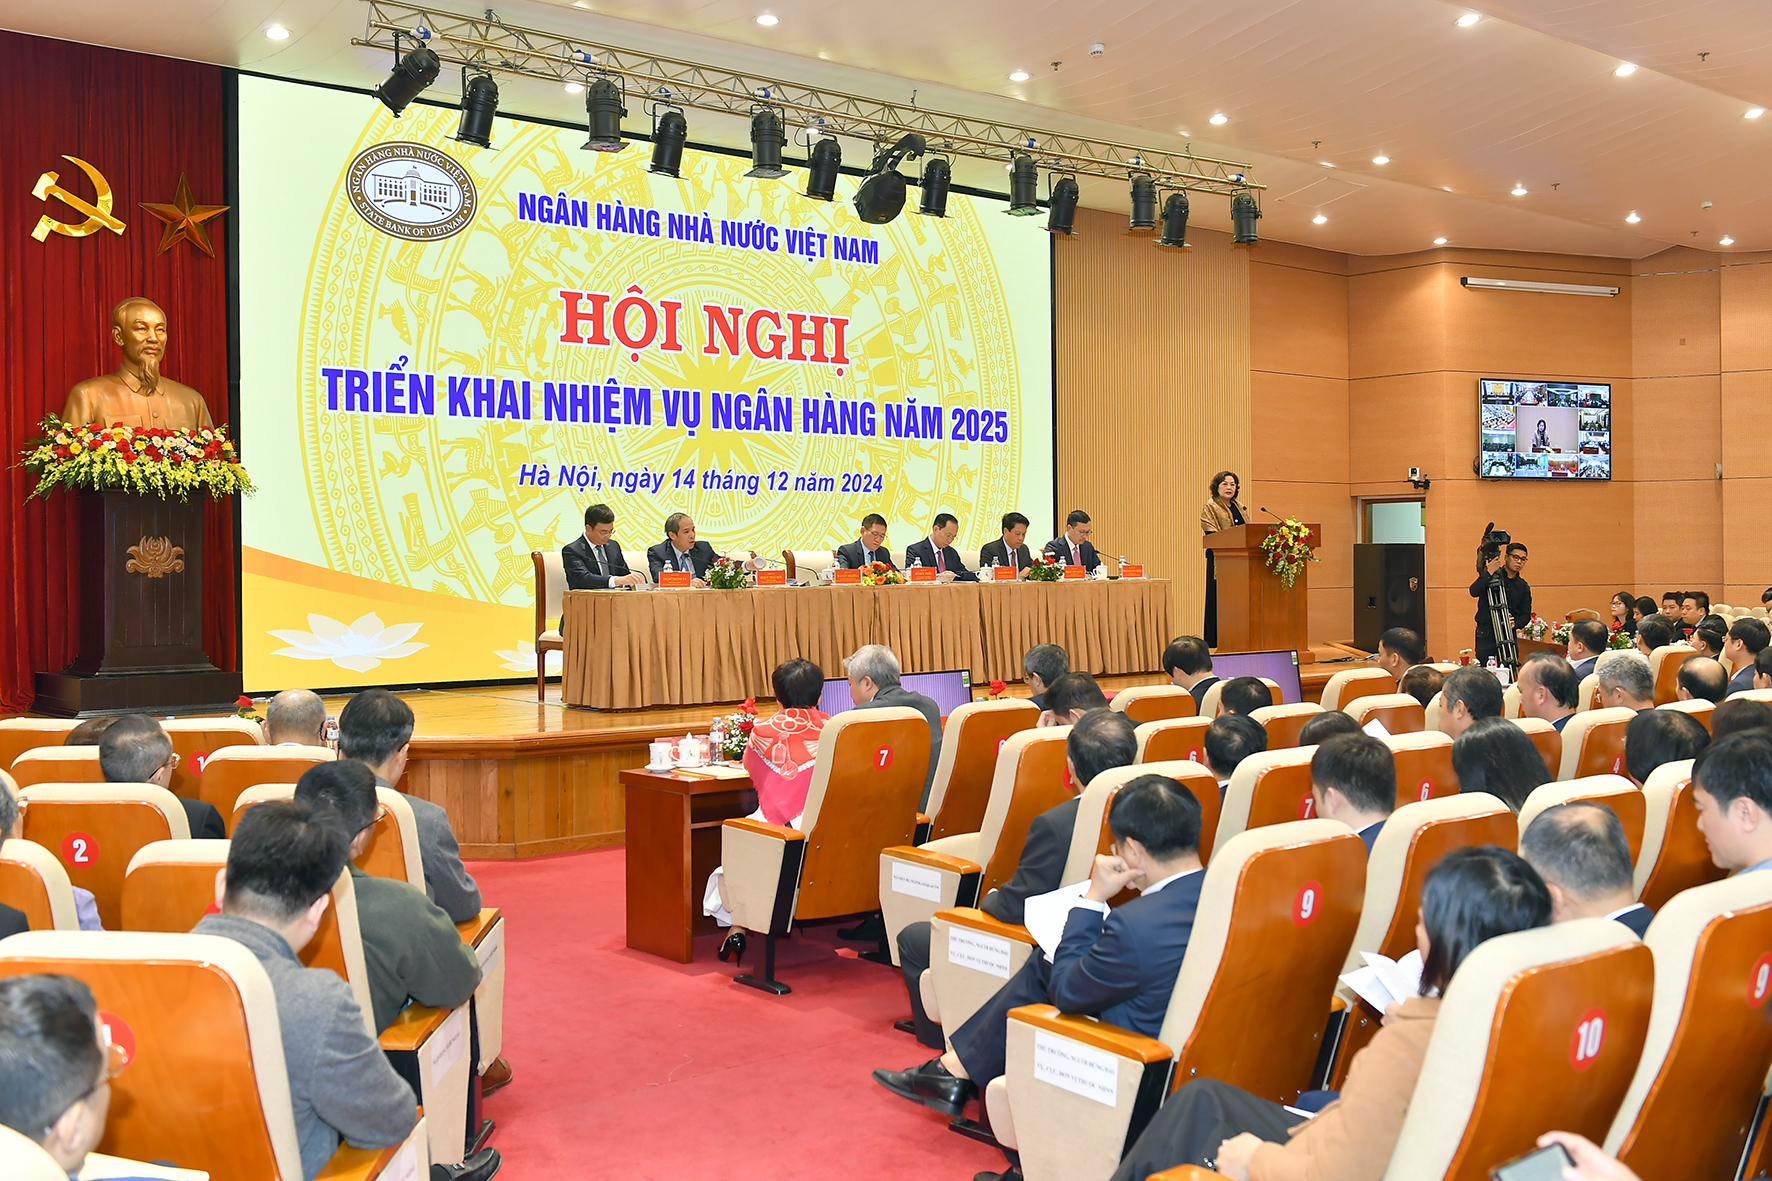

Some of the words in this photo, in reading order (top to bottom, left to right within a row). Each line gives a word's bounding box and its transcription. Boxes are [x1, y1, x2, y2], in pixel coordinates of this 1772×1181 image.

[352, 163, 367, 194] NGÂN
[364, 148, 392, 166] HÀNG
[394, 147, 414, 156] NHÀ
[416, 150, 444, 166] NƯỚC
[446, 162, 465, 182] VIỆT
[462, 184, 472, 208] NAM
[360, 202, 385, 224] STATE
[385, 220, 411, 235] BANK
[412, 228, 426, 236] OF
[426, 216, 465, 236] VIETNAM
[519, 192, 587, 228] NGÂN
[597, 200, 660, 237] HÀNG
[669, 212, 714, 244] NHÀ
[721, 220, 778, 251] NƯỚC
[785, 227, 827, 262] VIỆT
[834, 236, 878, 264] NAM
[561, 285, 682, 362] HỘI
[704, 306, 849, 376] NGHỊ
[322, 355, 434, 415] TRIỂN
[449, 376, 531, 420] KHAI
[544, 378, 651, 433] NHIỆM
[662, 390, 700, 436] VỤ
[712, 388, 792, 432] NGÂN
[803, 392, 875, 436] HÀNG
[885, 398, 942, 439] NĂM
[952, 408, 1007, 443] 2025
[519, 464, 549, 486] Hà
[559, 465, 601, 492] Nội,
[611, 467, 665, 494] ngày
[673, 469, 695, 488] 14
[703, 469, 759, 495] tháng
[768, 471, 788, 490] 12
[795, 472, 834, 491] năm
[841, 473, 882, 492] 2024
[196, 756, 204, 772] 1
[880, 750, 888, 766] 7
[1613, 758, 1620, 774] 4
[1420, 782, 1430, 802] 6
[1304, 798, 1313, 818] 7
[72, 838, 88, 862] 2
[1300, 889, 1314, 919] 9
[1754, 963, 1770, 998] 9
[1576, 1017, 1604, 1061] 10
